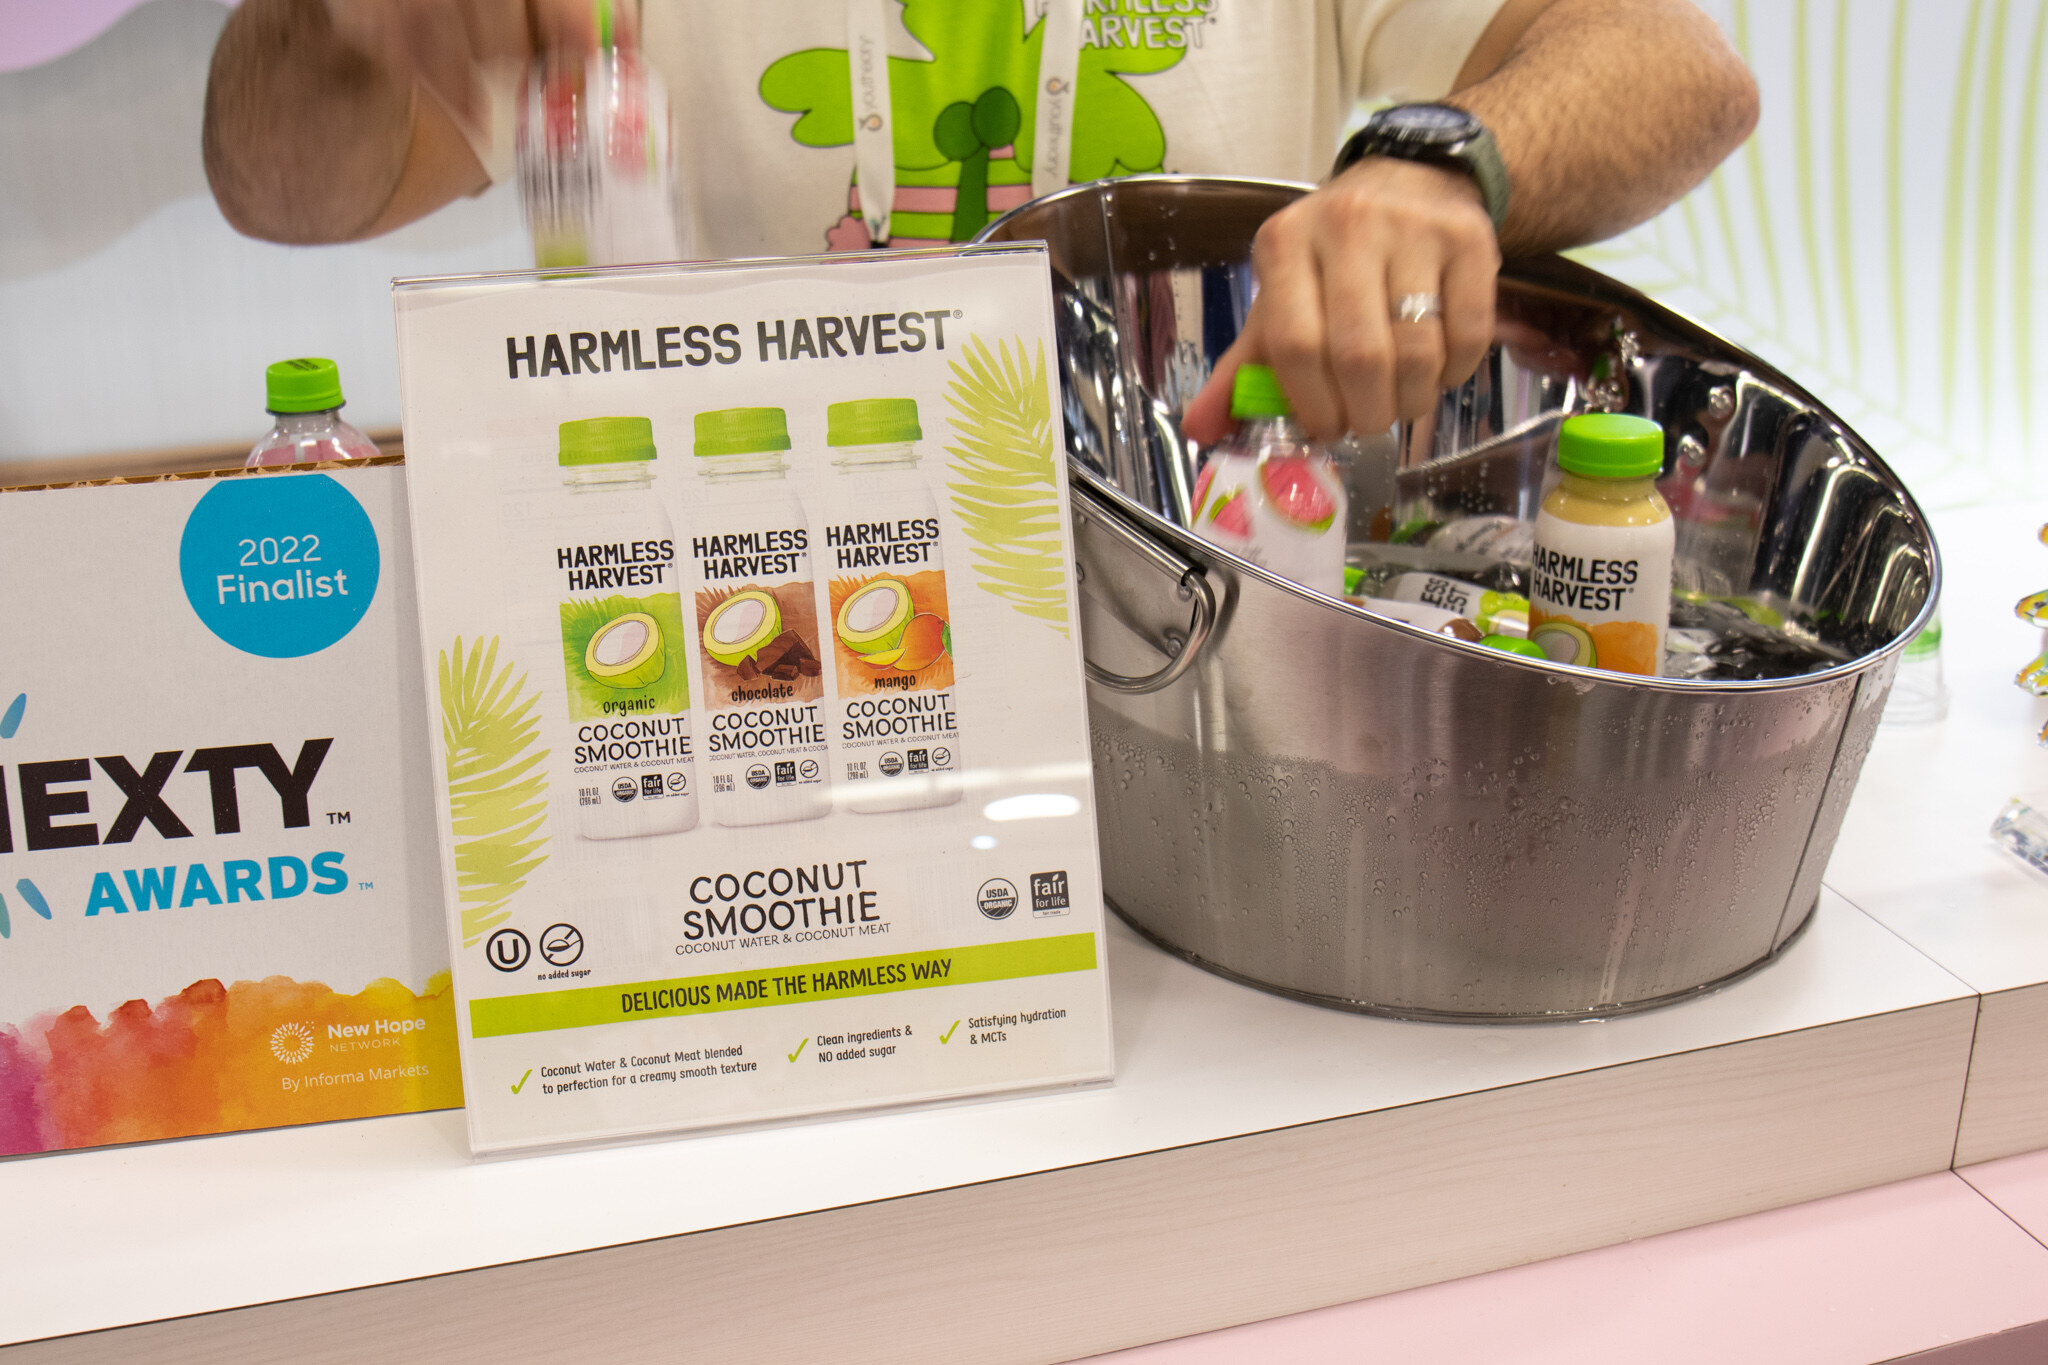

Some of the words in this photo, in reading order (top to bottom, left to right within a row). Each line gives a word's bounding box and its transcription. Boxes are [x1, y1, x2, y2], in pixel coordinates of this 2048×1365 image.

[506, 323, 741, 379] HARMLESS
[693, 529, 808, 558] HARMLESS
[826, 518, 939, 547] HARMLESS
[238, 534, 322, 567] 2022
[557, 540, 674, 569] HARMLESS
[1532, 541, 1639, 585] HARMLESS
[216, 569, 349, 605] Finalist
[732, 683, 793, 702] chocolate
[875, 675, 916, 690] mango
[603, 695, 655, 717] organic
[713, 706, 817, 731] COCONUT
[847, 694, 950, 718] COCONUT
[578, 718, 684, 743] COCONUT
[709, 724, 825, 752] SMOOTHIE
[842, 712, 957, 740] SMOOTHIE
[907, 734, 940, 743] COCONUT
[574, 736, 692, 764] SMOOTHIE
[909, 751, 926, 763] fair
[574, 764, 608, 773] COCONUT
[610, 762, 632, 770] WATER
[641, 759, 674, 768] COCONUT
[676, 756, 695, 764] MEAT
[776, 763, 794, 775] fair
[643, 776, 661, 788] fair
[0, 737, 334, 854] EXTY
[85, 851, 349, 917] AWARDS
[689, 860, 867, 904] COCONUT
[986, 888, 1009, 898] USDA
[1033, 874, 1065, 896] fair
[984, 899, 1013, 909] ORGANIC
[1035, 899, 1049, 908] for
[1051, 896, 1066, 906] life
[683, 891, 880, 940] SMOOTHIE
[675, 939, 736, 955] COCONUT
[739, 934, 780, 949] WATER
[782, 933, 792, 943] &
[795, 926, 855, 943] COCONUT
[858, 923, 891, 935] MEAT
[548, 969, 569, 979] added
[571, 969, 591, 978] sugar
[621, 985, 711, 1013] DELICIOUS
[716, 979, 768, 1003] MADE
[772, 974, 807, 996] THE
[812, 963, 907, 992] HARMLESS
[910, 958, 952, 980] WAY
[327, 1023, 369, 1039] New
[375, 1018, 426, 1035] Hope
[968, 1012, 1017, 1030] Satisfying
[1020, 1007, 1067, 1024] hydration
[329, 1037, 401, 1053] NETWORK
[817, 1032, 844, 1047] Clean
[847, 1026, 901, 1045] ingredients
[904, 1025, 913, 1036] &
[969, 1034, 978, 1045] &
[981, 1031, 1007, 1044] MCTs
[541, 1062, 582, 1078] Coconut
[585, 1059, 616, 1073] Water
[620, 1057, 628, 1068] &
[631, 1052, 671, 1067] Coconut
[674, 1049, 701, 1063] Meat
[704, 1045, 743, 1060] blended
[818, 1052, 833, 1063] NO
[836, 1047, 866, 1061] added
[869, 1044, 897, 1059] sugar
[281, 1077, 300, 1093] By
[304, 1070, 364, 1088] Informa
[369, 1064, 430, 1082] Markets
[542, 1083, 554, 1095] to
[557, 1074, 609, 1096] perfection
[612, 1074, 627, 1087] for
[630, 1074, 637, 1084] a
[639, 1069, 677, 1084] creamy
[679, 1064, 718, 1080] smooth
[720, 1061, 757, 1076] texture
